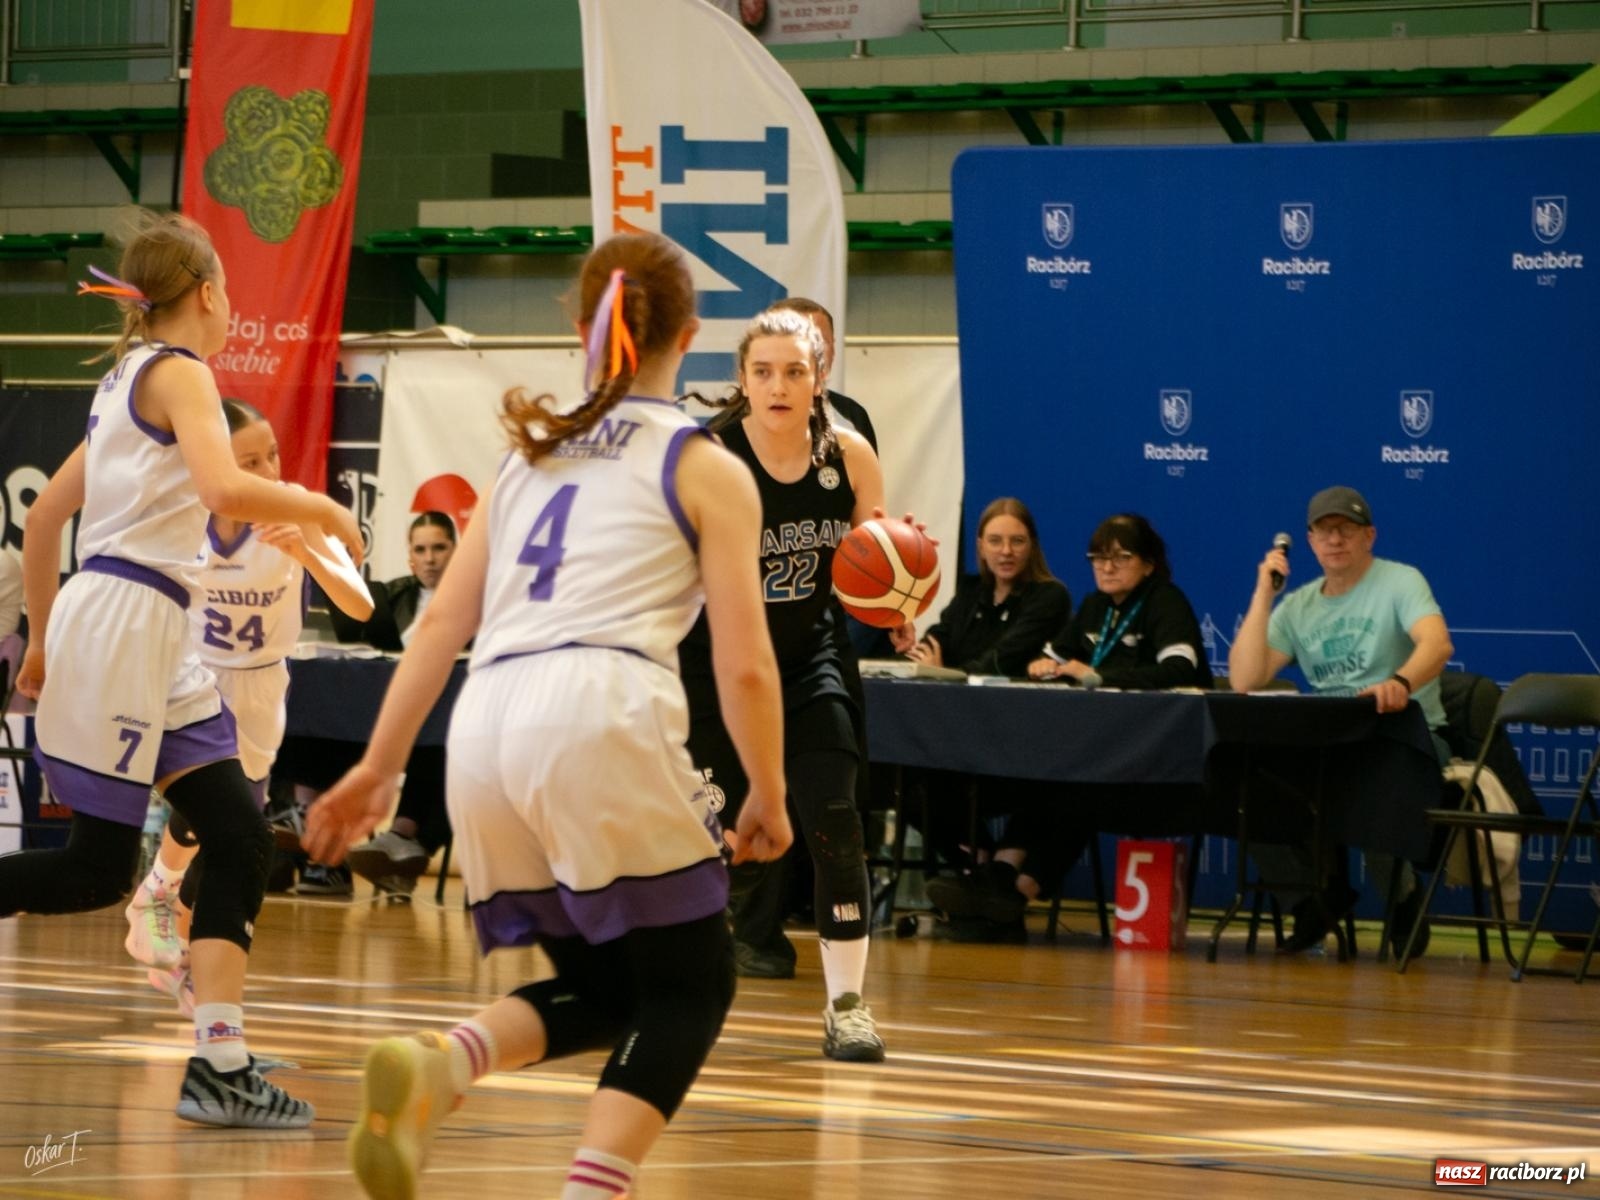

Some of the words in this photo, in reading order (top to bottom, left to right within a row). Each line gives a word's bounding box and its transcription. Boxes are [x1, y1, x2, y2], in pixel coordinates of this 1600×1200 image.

[1026, 256, 1091, 274] Racibórz
[1262, 256, 1330, 274] Racibórz
[1512, 251, 1583, 270] Racibórz
[273, 315, 308, 341] coś
[214, 345, 281, 375] siebie
[1144, 442, 1209, 461] Racibórz
[1381, 445, 1449, 463] Racibórz
[517, 484, 579, 602] 4
[763, 551, 819, 602] 22
[203, 607, 265, 652] 24
[115, 728, 142, 774] 7
[1115, 852, 1154, 922] 5
